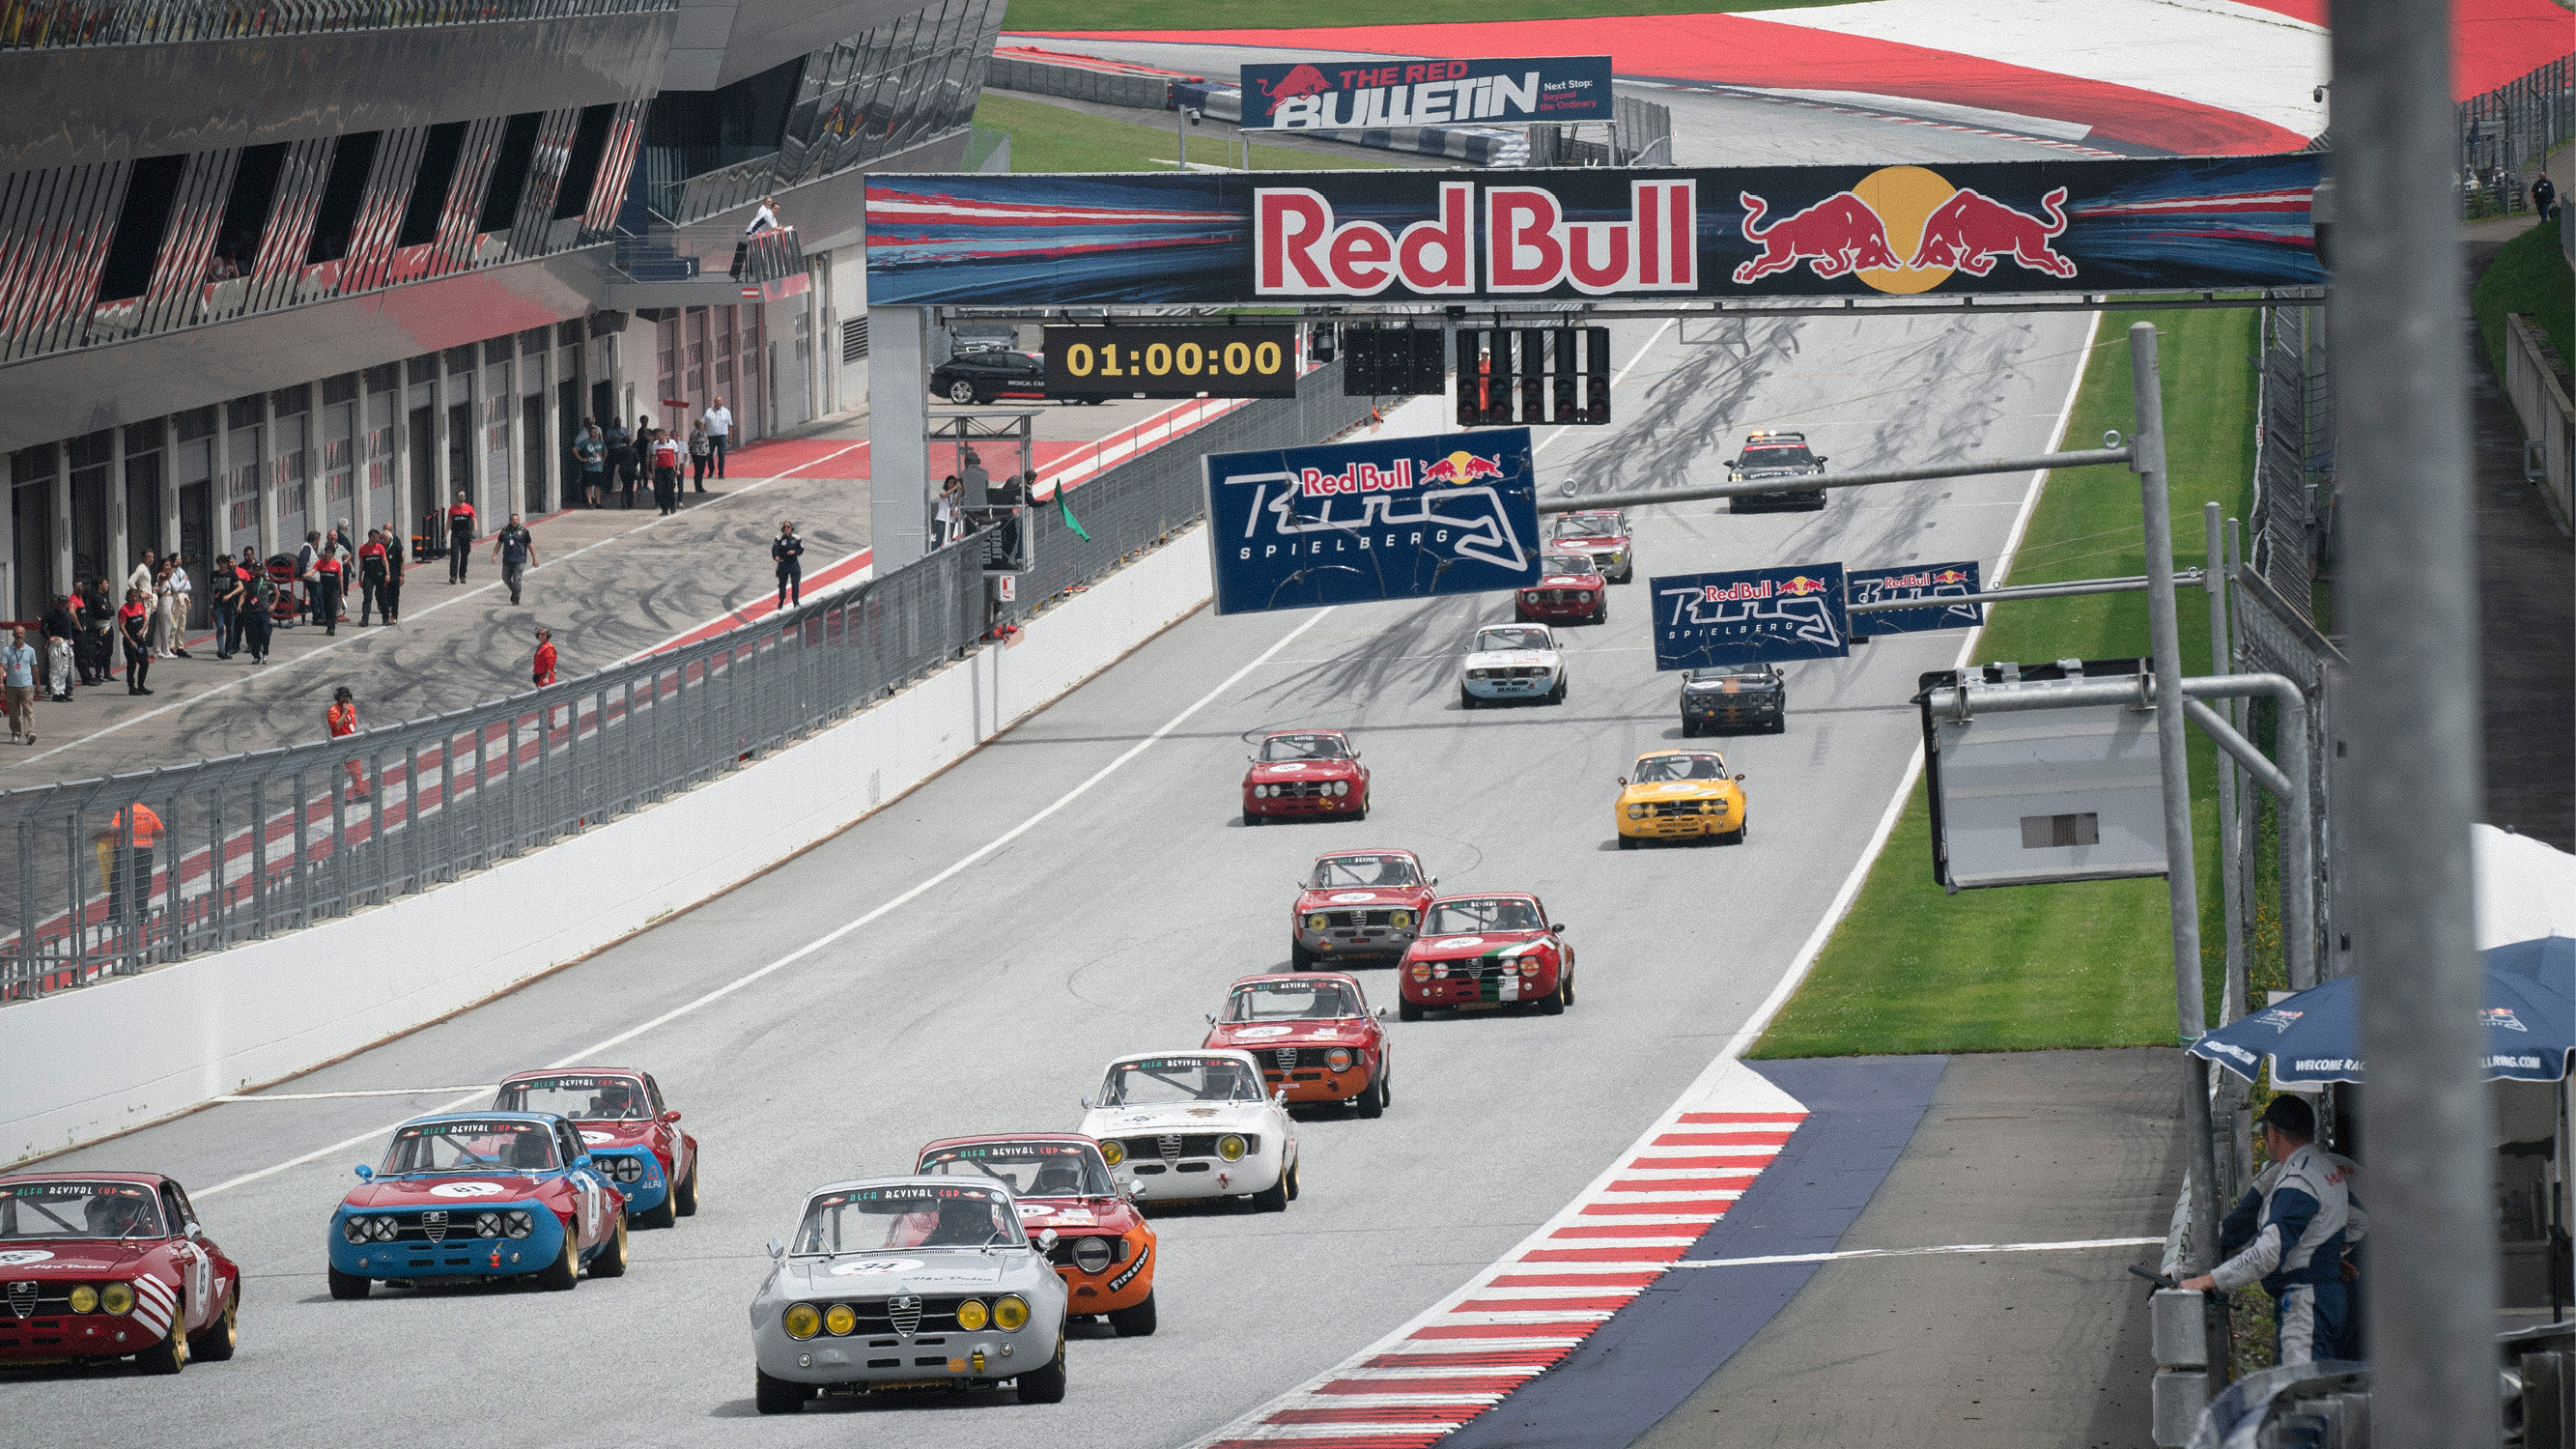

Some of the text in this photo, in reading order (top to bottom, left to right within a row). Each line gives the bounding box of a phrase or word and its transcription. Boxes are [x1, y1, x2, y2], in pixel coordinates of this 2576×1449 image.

[1339, 60, 1468, 90] THE RED
[1543, 79, 1593, 92] Next Stop:
[1543, 90, 1576, 101] Beyond
[1540, 99, 1597, 111] the Ordinary
[1259, 182, 1694, 292] Red Bull
[1066, 341, 1282, 377] 01:00:00
[1302, 458, 1413, 497] Red Bull
[1240, 529, 1448, 559] SPIELBERG
[1884, 572, 1930, 589] Red Bull
[1705, 580, 1771, 602] Red Bull
[1669, 622, 1794, 639] SPIELBERG
[2295, 1058, 2366, 1071] WELCOME RAC
[2481, 1054, 2541, 1069] LLRING.COM
[451, 1124, 489, 1134] REVIVAL
[493, 1123, 511, 1132] CUP
[960, 1146, 1059, 1158] ALFA REVIVAL CUP
[16, 1186, 118, 1196] ALFA REVIVAL CUP
[849, 1188, 960, 1202] ALFA REVIVAL CUP
[854, 1263, 899, 1271] 34
[1111, 1246, 1149, 1291] Firestone
